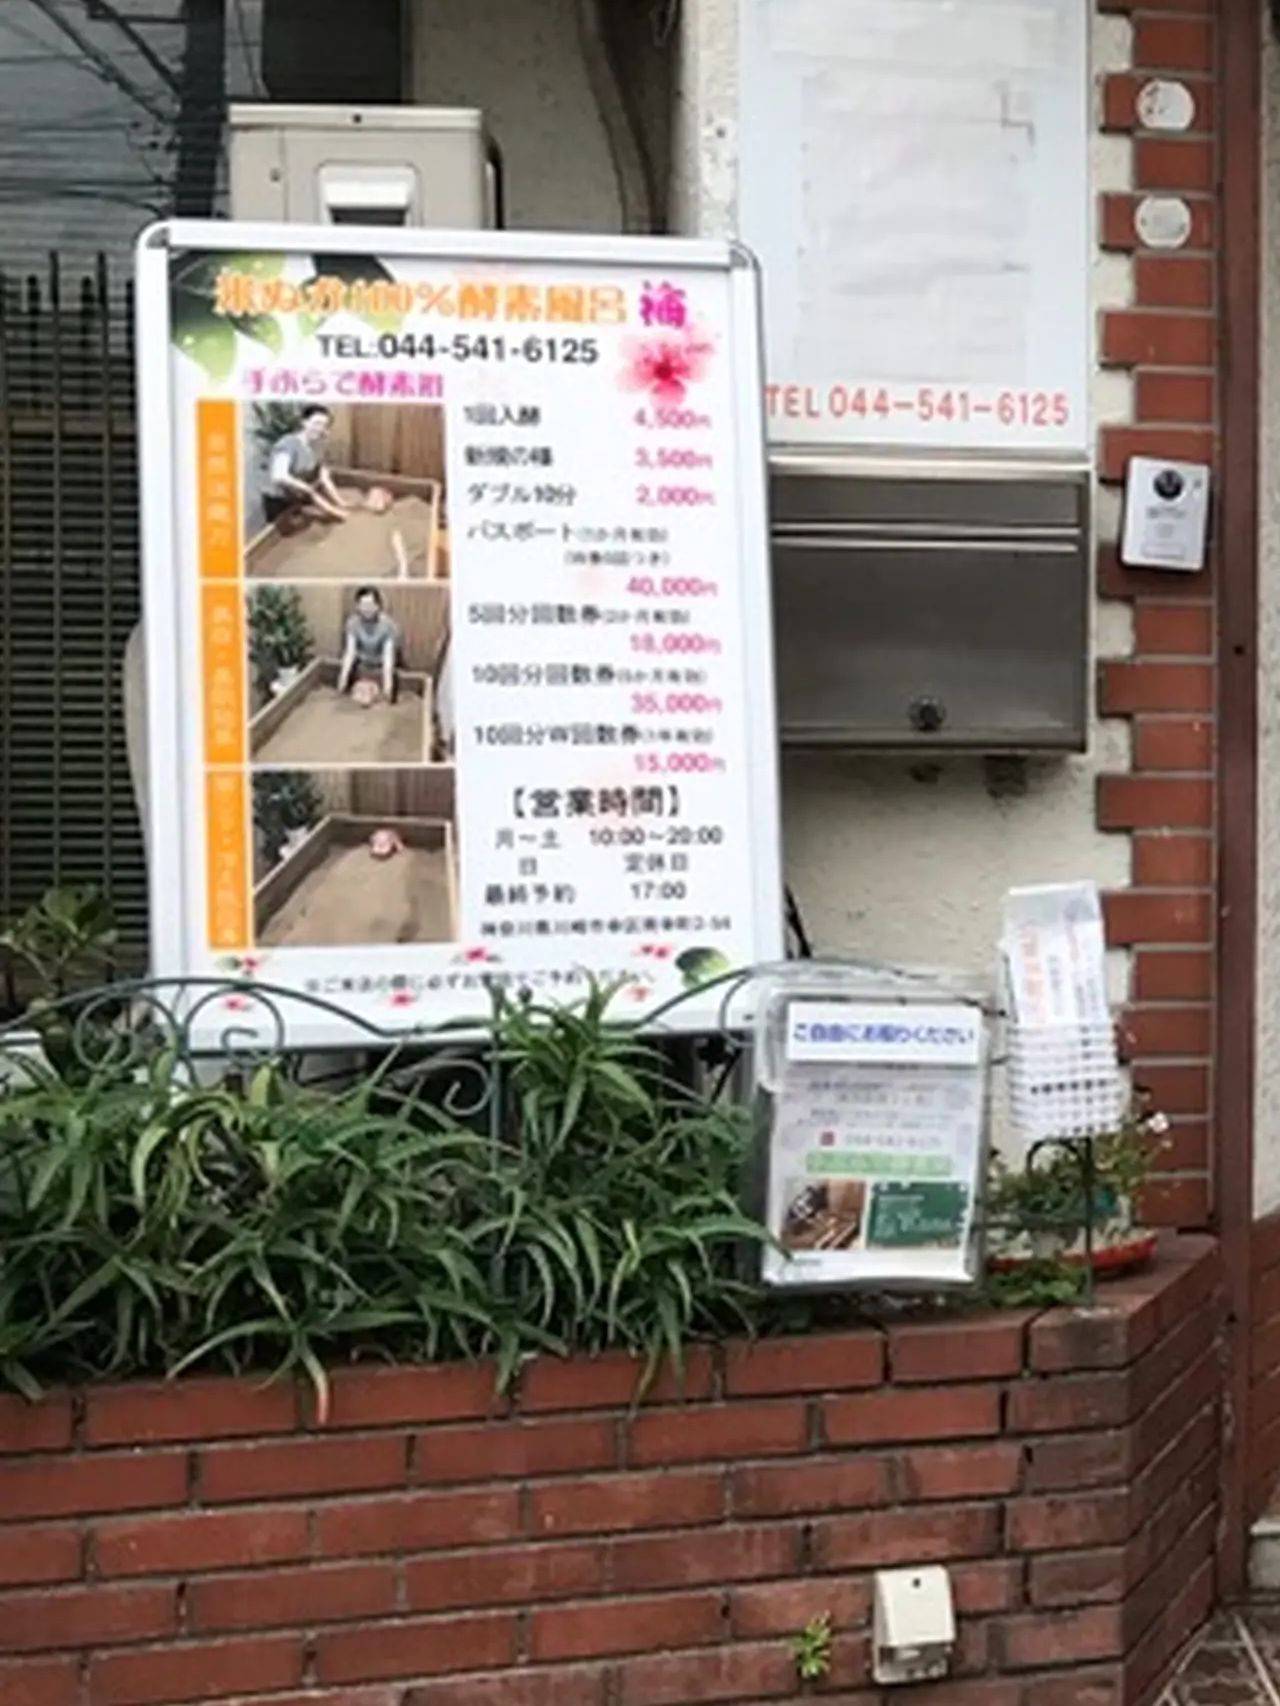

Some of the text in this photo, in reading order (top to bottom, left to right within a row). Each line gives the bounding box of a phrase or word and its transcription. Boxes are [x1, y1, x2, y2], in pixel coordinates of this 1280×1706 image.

[318, 334, 599, 363] TEL:044-541-6125
[765, 384, 1069, 426] TEL 044-541-6125
